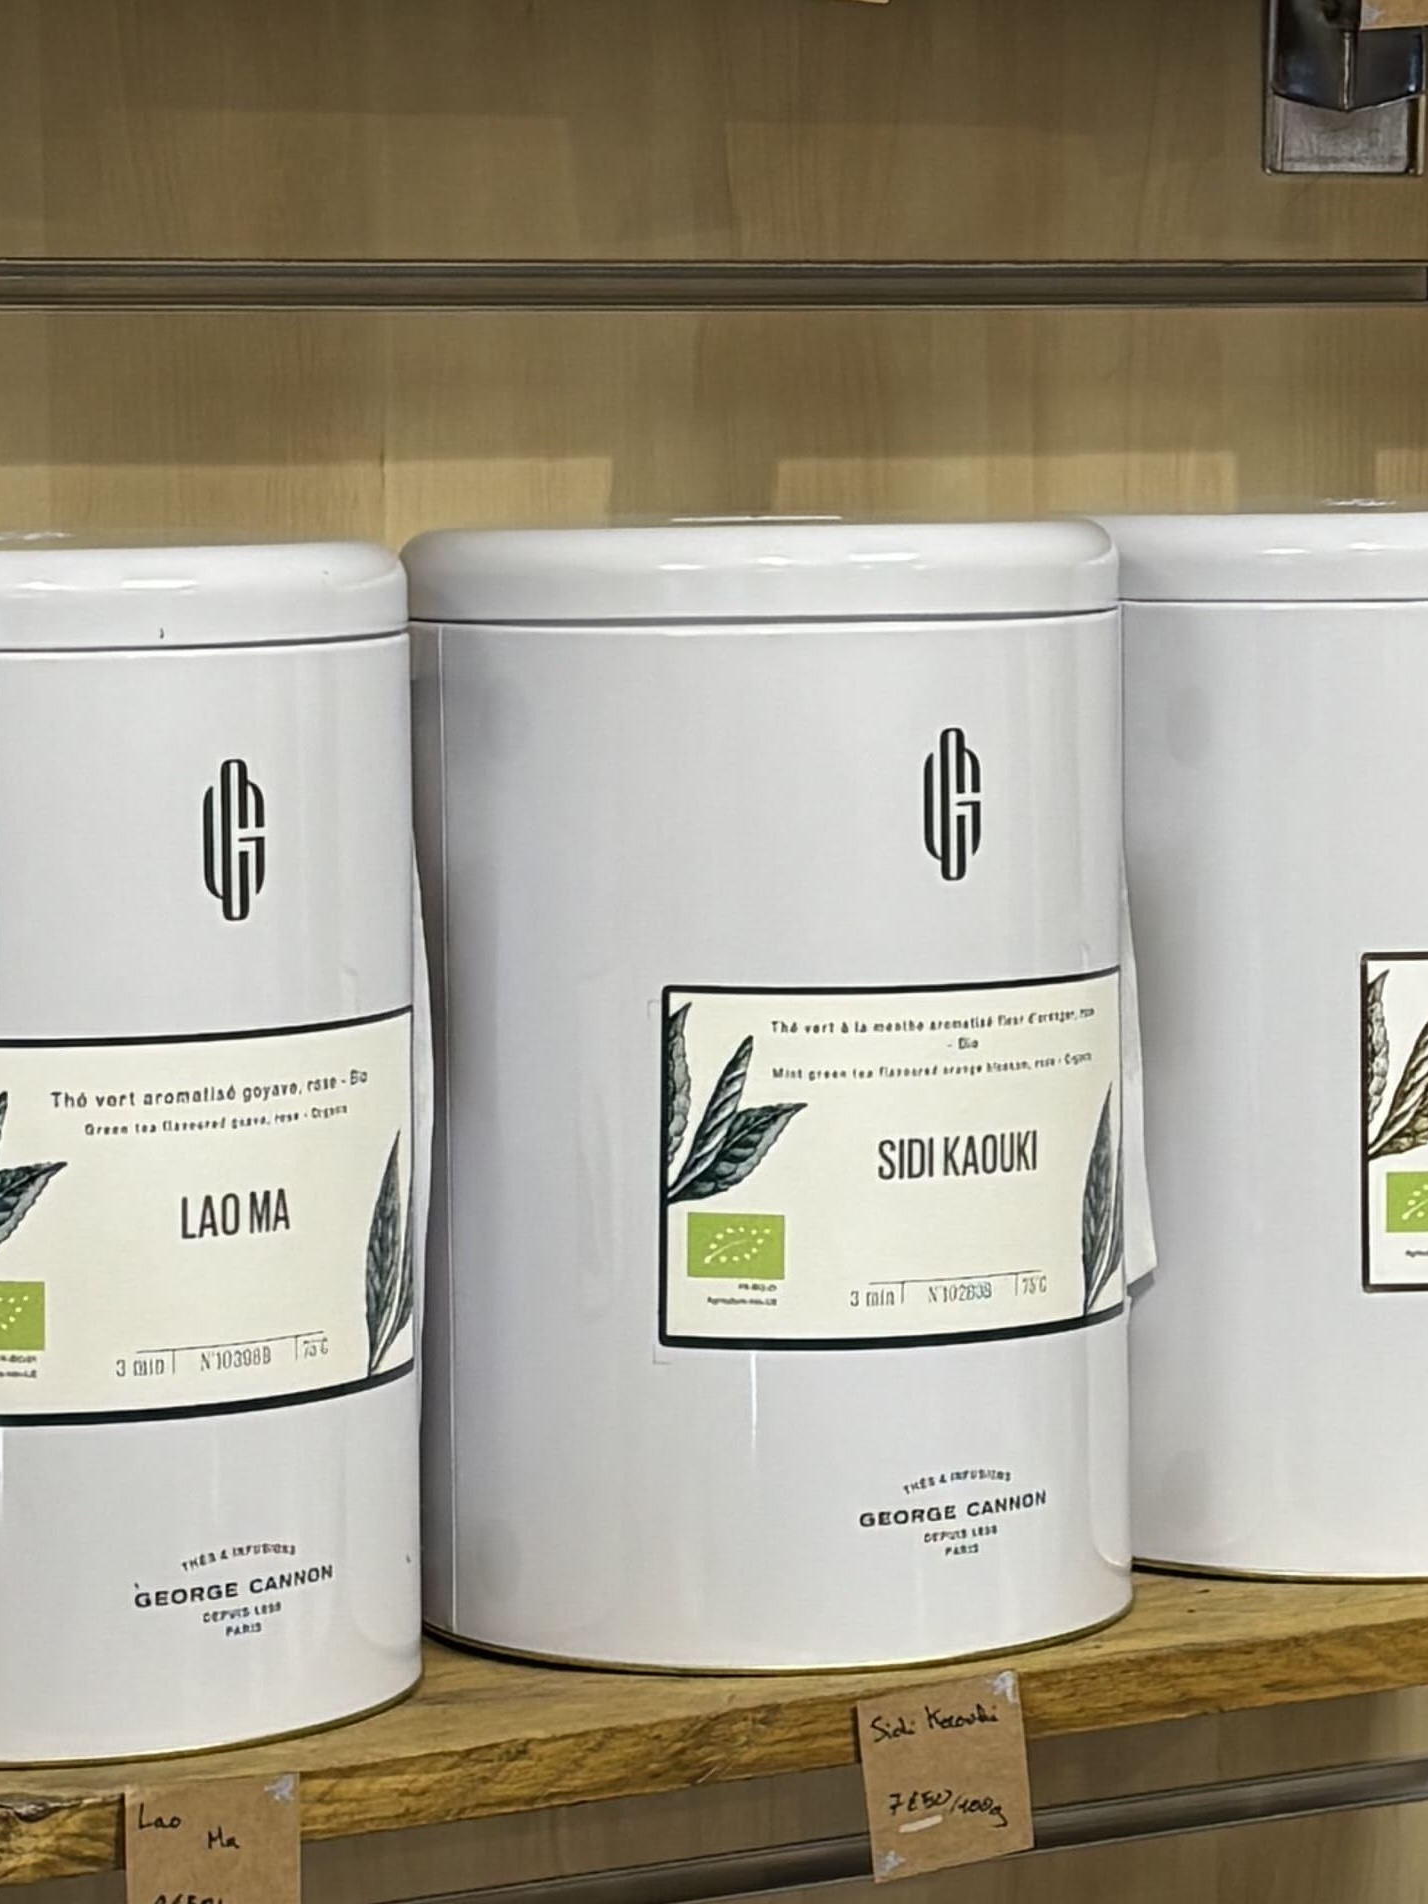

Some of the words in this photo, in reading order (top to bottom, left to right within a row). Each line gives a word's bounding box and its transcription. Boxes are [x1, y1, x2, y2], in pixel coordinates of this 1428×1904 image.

[51, 1092, 87, 1108] Thé
[96, 1092, 135, 1107] vert
[878, 1137, 933, 1180] SIDI
[944, 1130, 1037, 1176] KAOUKI
[182, 1193, 240, 1239] LAO
[250, 1188, 290, 1233] MA
[860, 1505, 956, 1527] GEORGE
[967, 1490, 1046, 1516] CANNON
[135, 1583, 238, 1608] GEORGE
[250, 1565, 332, 1593] CANNON
[138, 1803, 181, 1829] Lao
[208, 1826, 240, 1849] Ma
